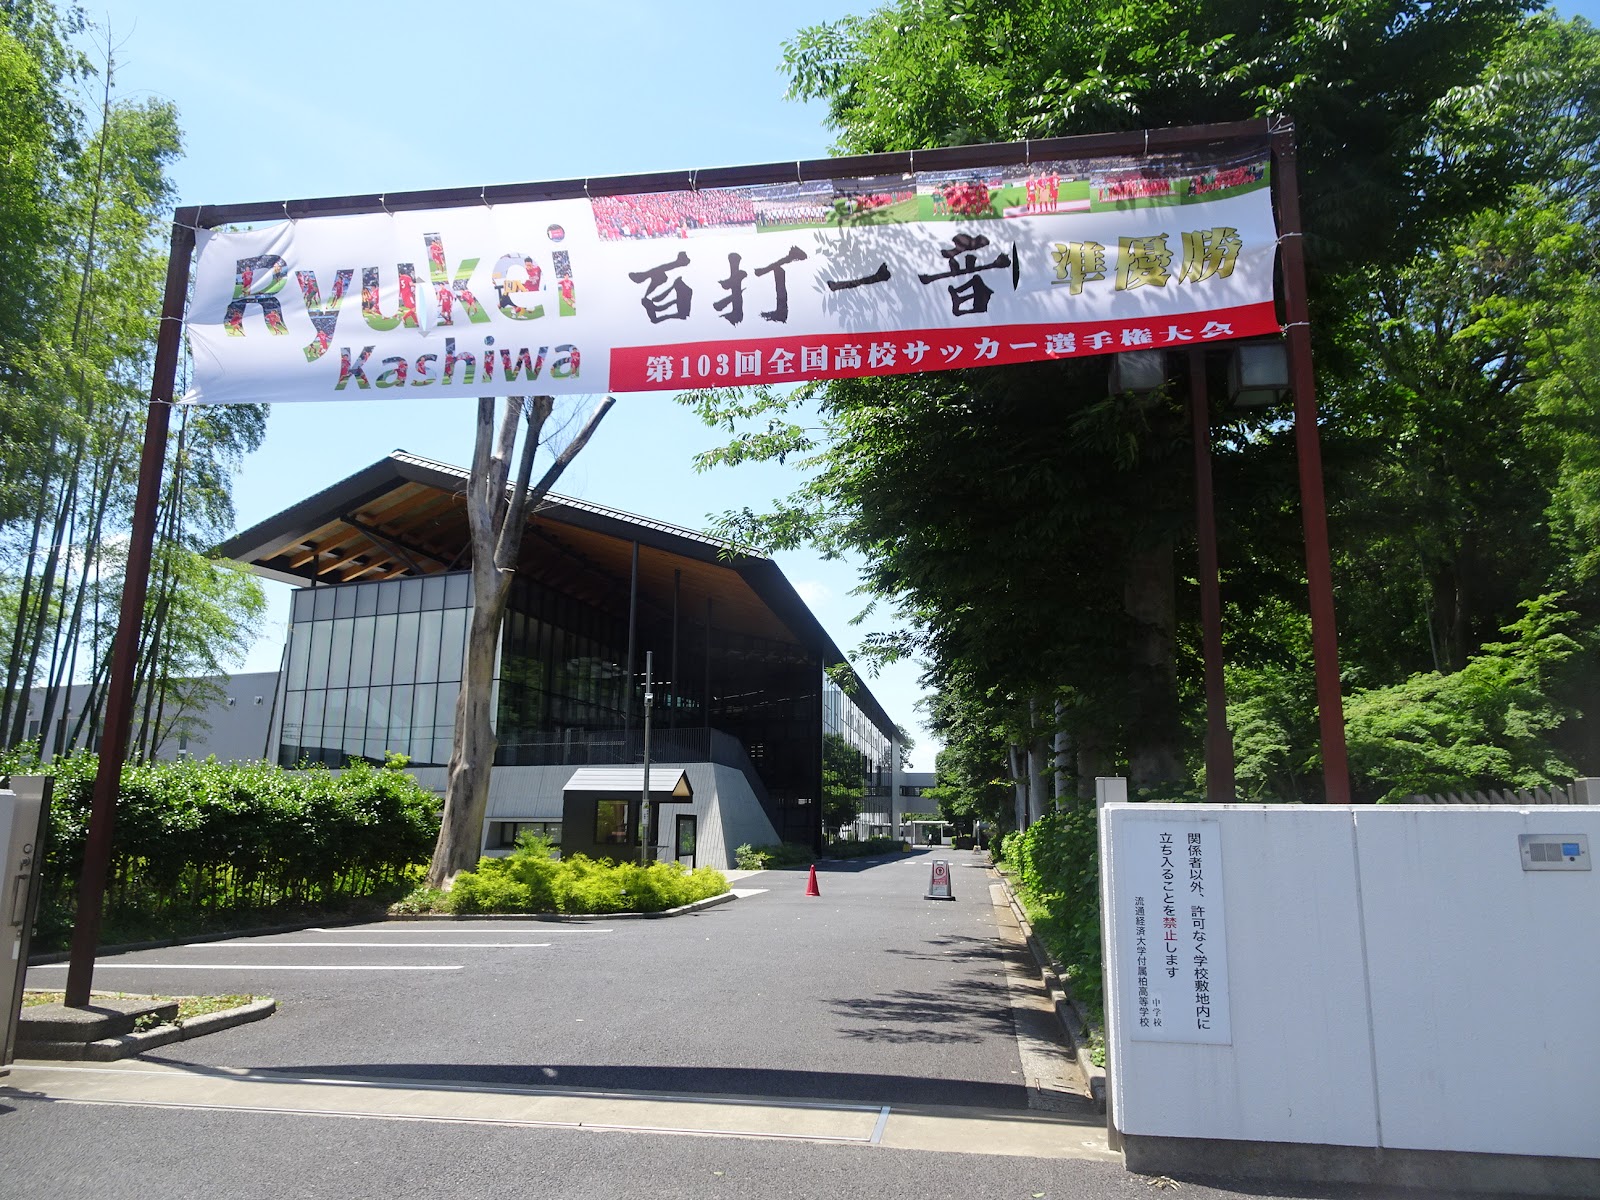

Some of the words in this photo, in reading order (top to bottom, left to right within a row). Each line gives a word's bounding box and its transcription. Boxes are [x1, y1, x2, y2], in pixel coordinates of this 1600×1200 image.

[223, 223, 577, 363] Ryukei
[1050, 226, 1243, 296] 準優勝
[334, 335, 581, 391] Kashiwa
[645, 321, 1235, 383] 第103回全国高校サッカー選手権大会
[1159, 832, 1179, 978] 立ち入ることを禁止します
[1152, 998, 1162, 1027] 中学校
